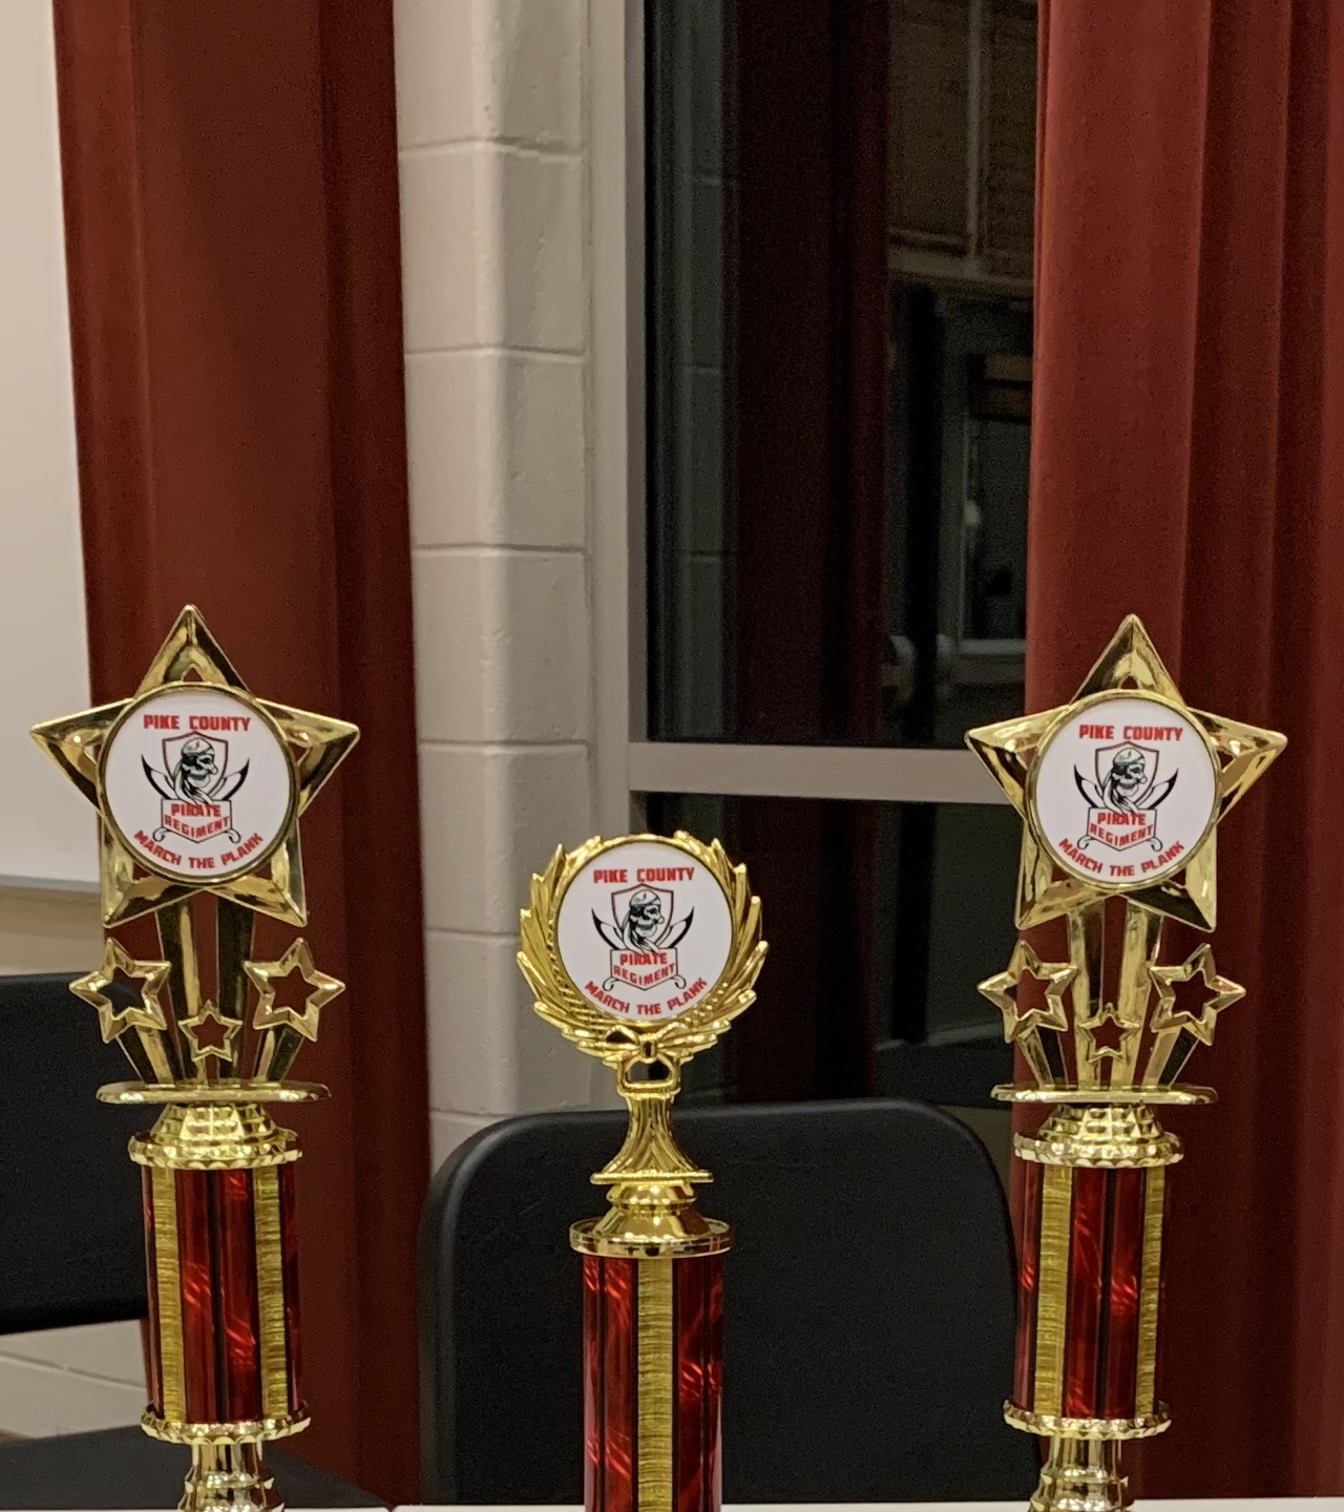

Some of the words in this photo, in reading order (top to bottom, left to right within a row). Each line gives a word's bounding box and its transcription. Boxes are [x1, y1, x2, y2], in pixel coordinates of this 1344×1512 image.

[144, 715, 180, 729] PIKE
[189, 715, 251, 731] COUNTY
[1079, 725, 1114, 739] PIKE
[1123, 726, 1183, 741] COUNTY
[171, 804, 221, 816] PIRATE
[1097, 813, 1146, 825] PIRATE
[165, 815, 230, 839] REGIMENT
[1090, 823, 1154, 847] REGIMENT
[134, 830, 181, 865] MARCH
[188, 857, 215, 869] THE
[221, 833, 263, 865] PLANK
[1059, 838, 1103, 873] MARCH
[1109, 865, 1135, 876] THE
[1141, 841, 1185, 873] PLANK
[593, 870, 627, 883] PIKE
[637, 867, 695, 882] COUNTY
[620, 953, 667, 965] PIRATE
[613, 964, 676, 986] REGIMENT
[585, 981, 630, 1013] MARCH
[637, 1004, 662, 1015] THE
[667, 977, 707, 1011] PLANK
